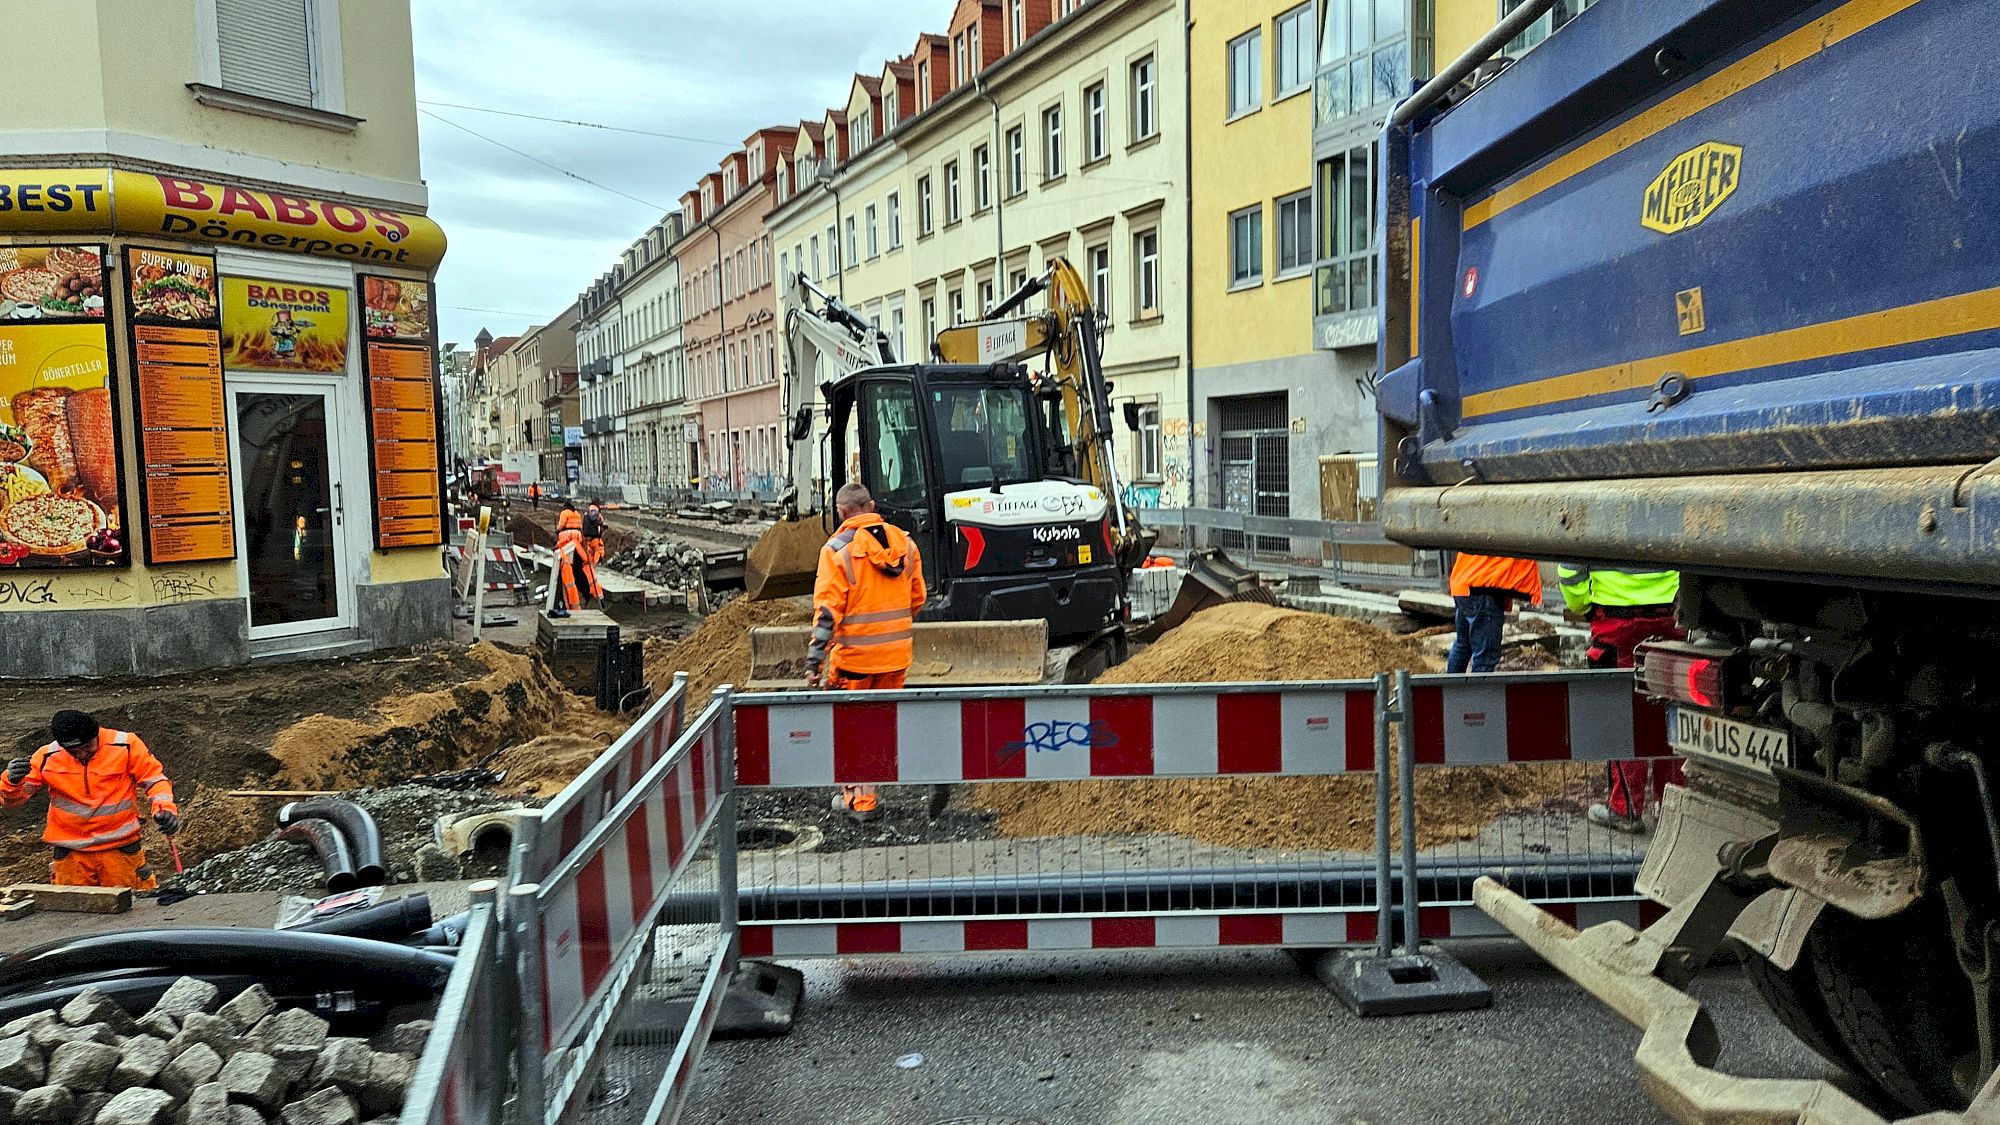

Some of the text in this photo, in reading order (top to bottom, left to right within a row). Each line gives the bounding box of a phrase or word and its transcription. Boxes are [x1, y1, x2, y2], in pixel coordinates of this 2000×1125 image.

[1645, 150, 1736, 226] MEILLER
[154, 175, 411, 242] BABOS
[160, 213, 410, 264] Dönerpoint
[141, 252, 208, 280] SUPER DÖNER
[247, 284, 331, 306] BABOS
[43, 360, 103, 382] DÖNERTELLER
[998, 501, 1038, 512] EIFFAGE
[1033, 525, 1080, 542] Kubota
[1679, 711, 1785, 768] DW US 444
